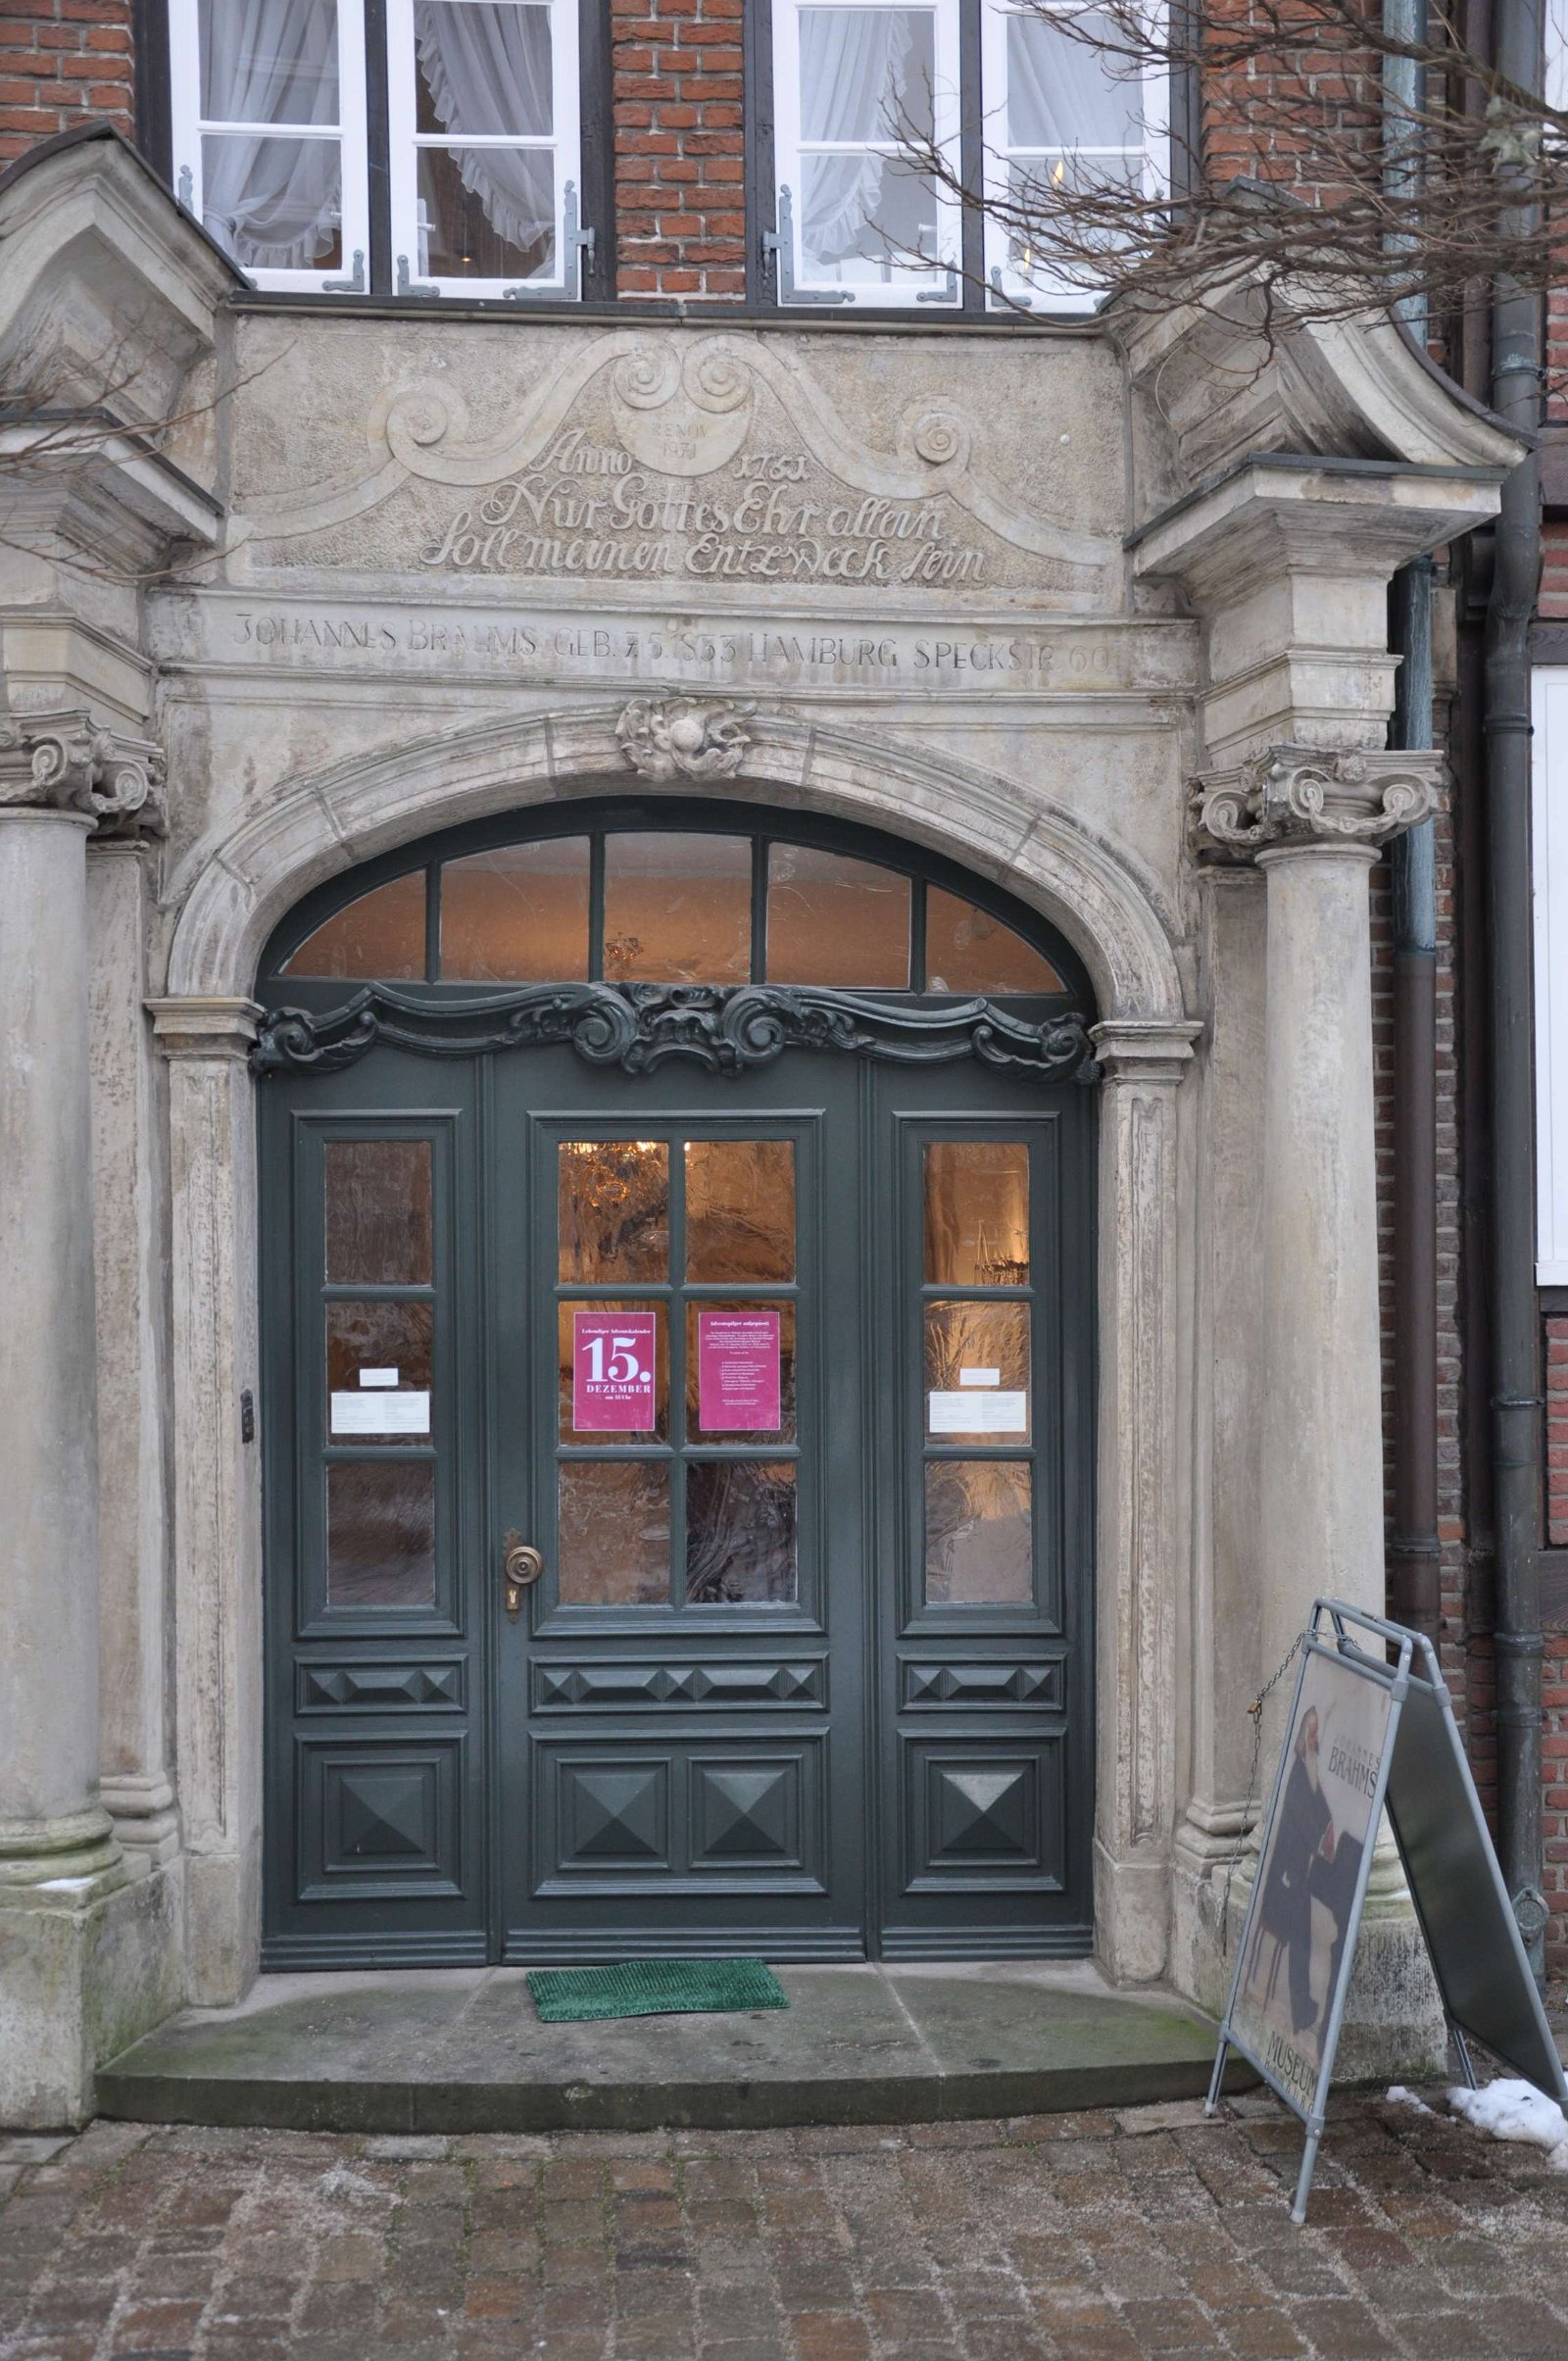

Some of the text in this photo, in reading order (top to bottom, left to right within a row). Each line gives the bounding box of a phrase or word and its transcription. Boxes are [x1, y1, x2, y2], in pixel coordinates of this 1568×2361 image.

[527, 428, 632, 475] Anno
[480, 473, 608, 530] Nur
[609, 472, 730, 534] Gottes
[733, 481, 822, 536] Ehr
[520, 537, 677, 573] meinen
[234, 613, 397, 649] JOHANNES
[408, 618, 537, 656] BRAHMS
[554, 626, 616, 658] GEB.
[749, 632, 898, 667] HAMBURG
[581, 1336, 652, 1383] 15.
[586, 1384, 651, 1394] DEZEMBER
[1328, 1746, 1378, 1799] BRAHMS
[1267, 2030, 1319, 2102] MUSEUM
